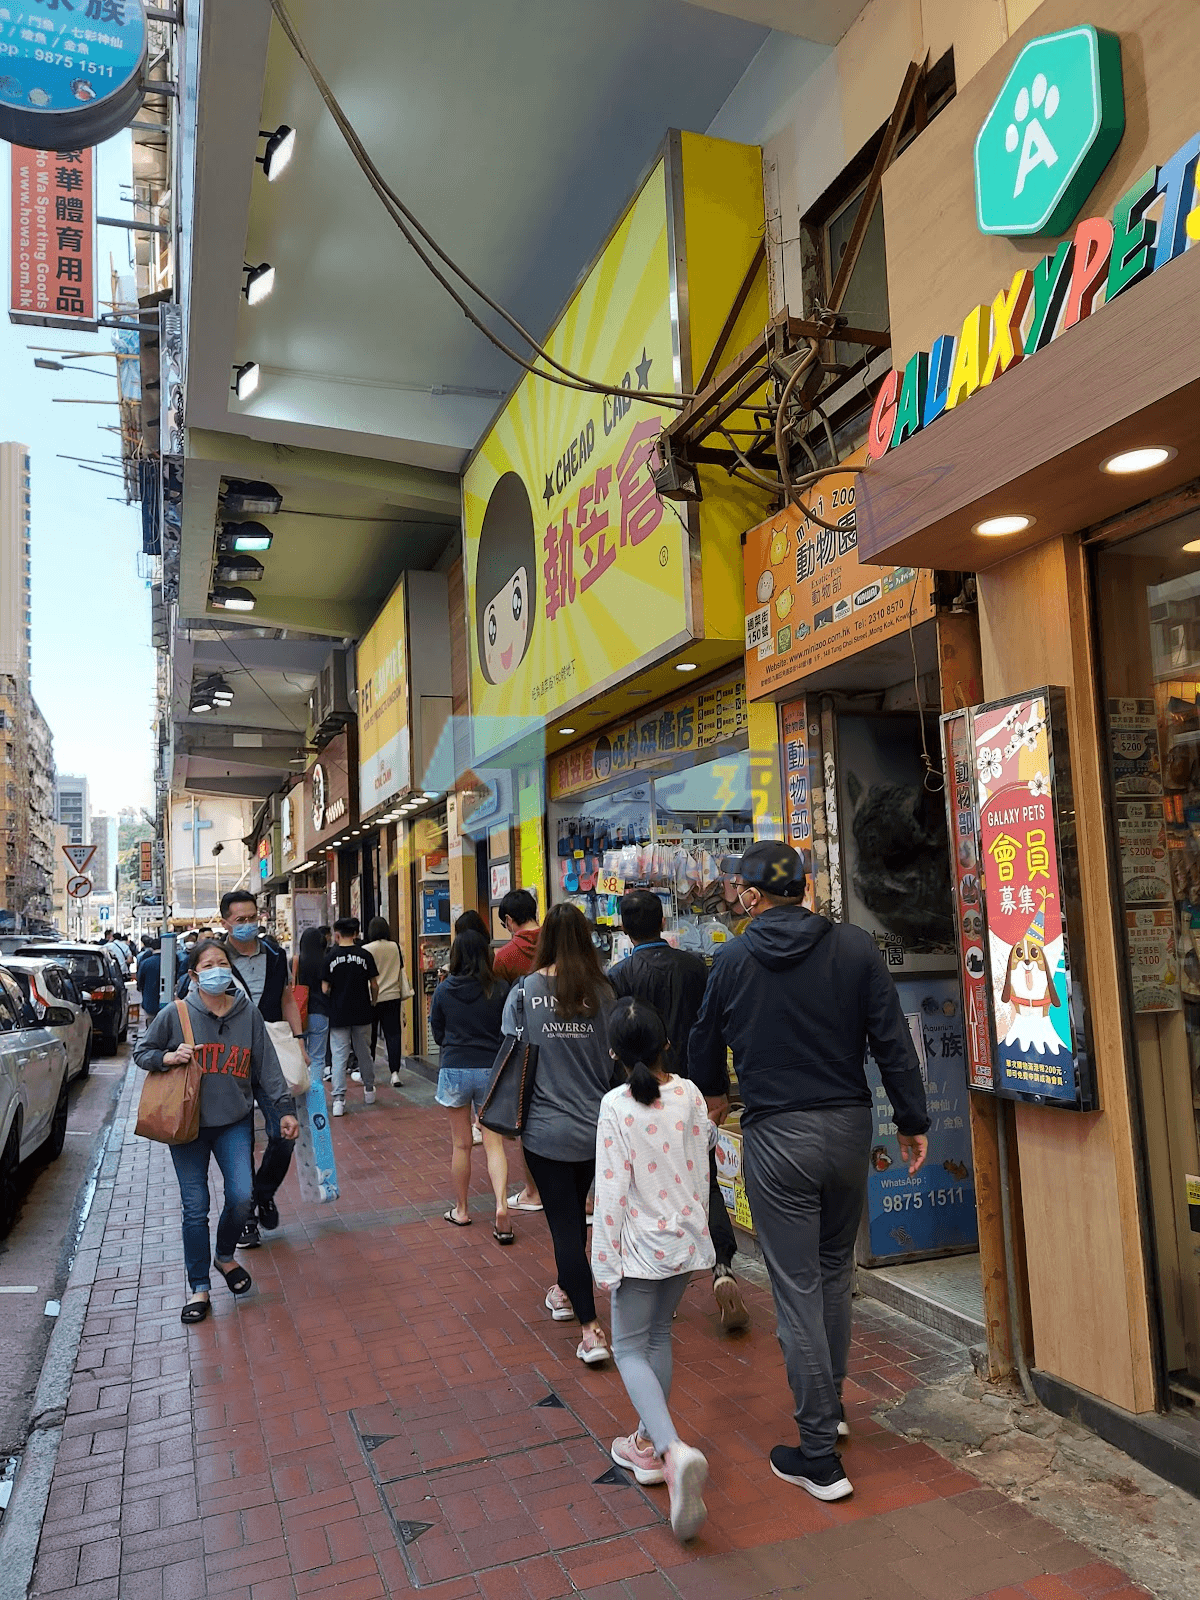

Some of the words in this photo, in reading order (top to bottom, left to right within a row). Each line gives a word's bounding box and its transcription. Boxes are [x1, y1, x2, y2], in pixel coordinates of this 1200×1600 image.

[34, 48, 74, 69] 9875
[79, 59, 114, 78] 1511
[36, 172, 48, 194] Wa
[19, 165, 33, 308] www.howa.com.hk
[36, 197, 50, 261] Sporting
[36, 265, 49, 310] Goods
[555, 418, 595, 497] CHEAP
[810, 575, 843, 607] 動物部
[765, 658, 790, 675] Website:
[789, 627, 851, 663] www.minizoo.com.hk
[853, 617, 868, 632] Tel:
[868, 609, 886, 626] 2310
[886, 598, 905, 615] 8570
[1121, 742, 1142, 752] $200
[786, 740, 811, 842] 動物部
[954, 757, 974, 838] 動物部
[987, 810, 1023, 828] GALAXY
[1021, 805, 1046, 823] PETS
[987, 828, 1051, 882] 會員
[1129, 847, 1151, 856] $200
[602, 877, 618, 892] $8
[999, 884, 1037, 916] 募集
[1138, 955, 1160, 965] $100
[541, 1022, 595, 1033] ANVERSA
[943, 1115, 964, 1130] 金魚
[880, 1176, 922, 1189] WhatsApp
[882, 1191, 924, 1214] 9875
[927, 1186, 964, 1208] 1511
